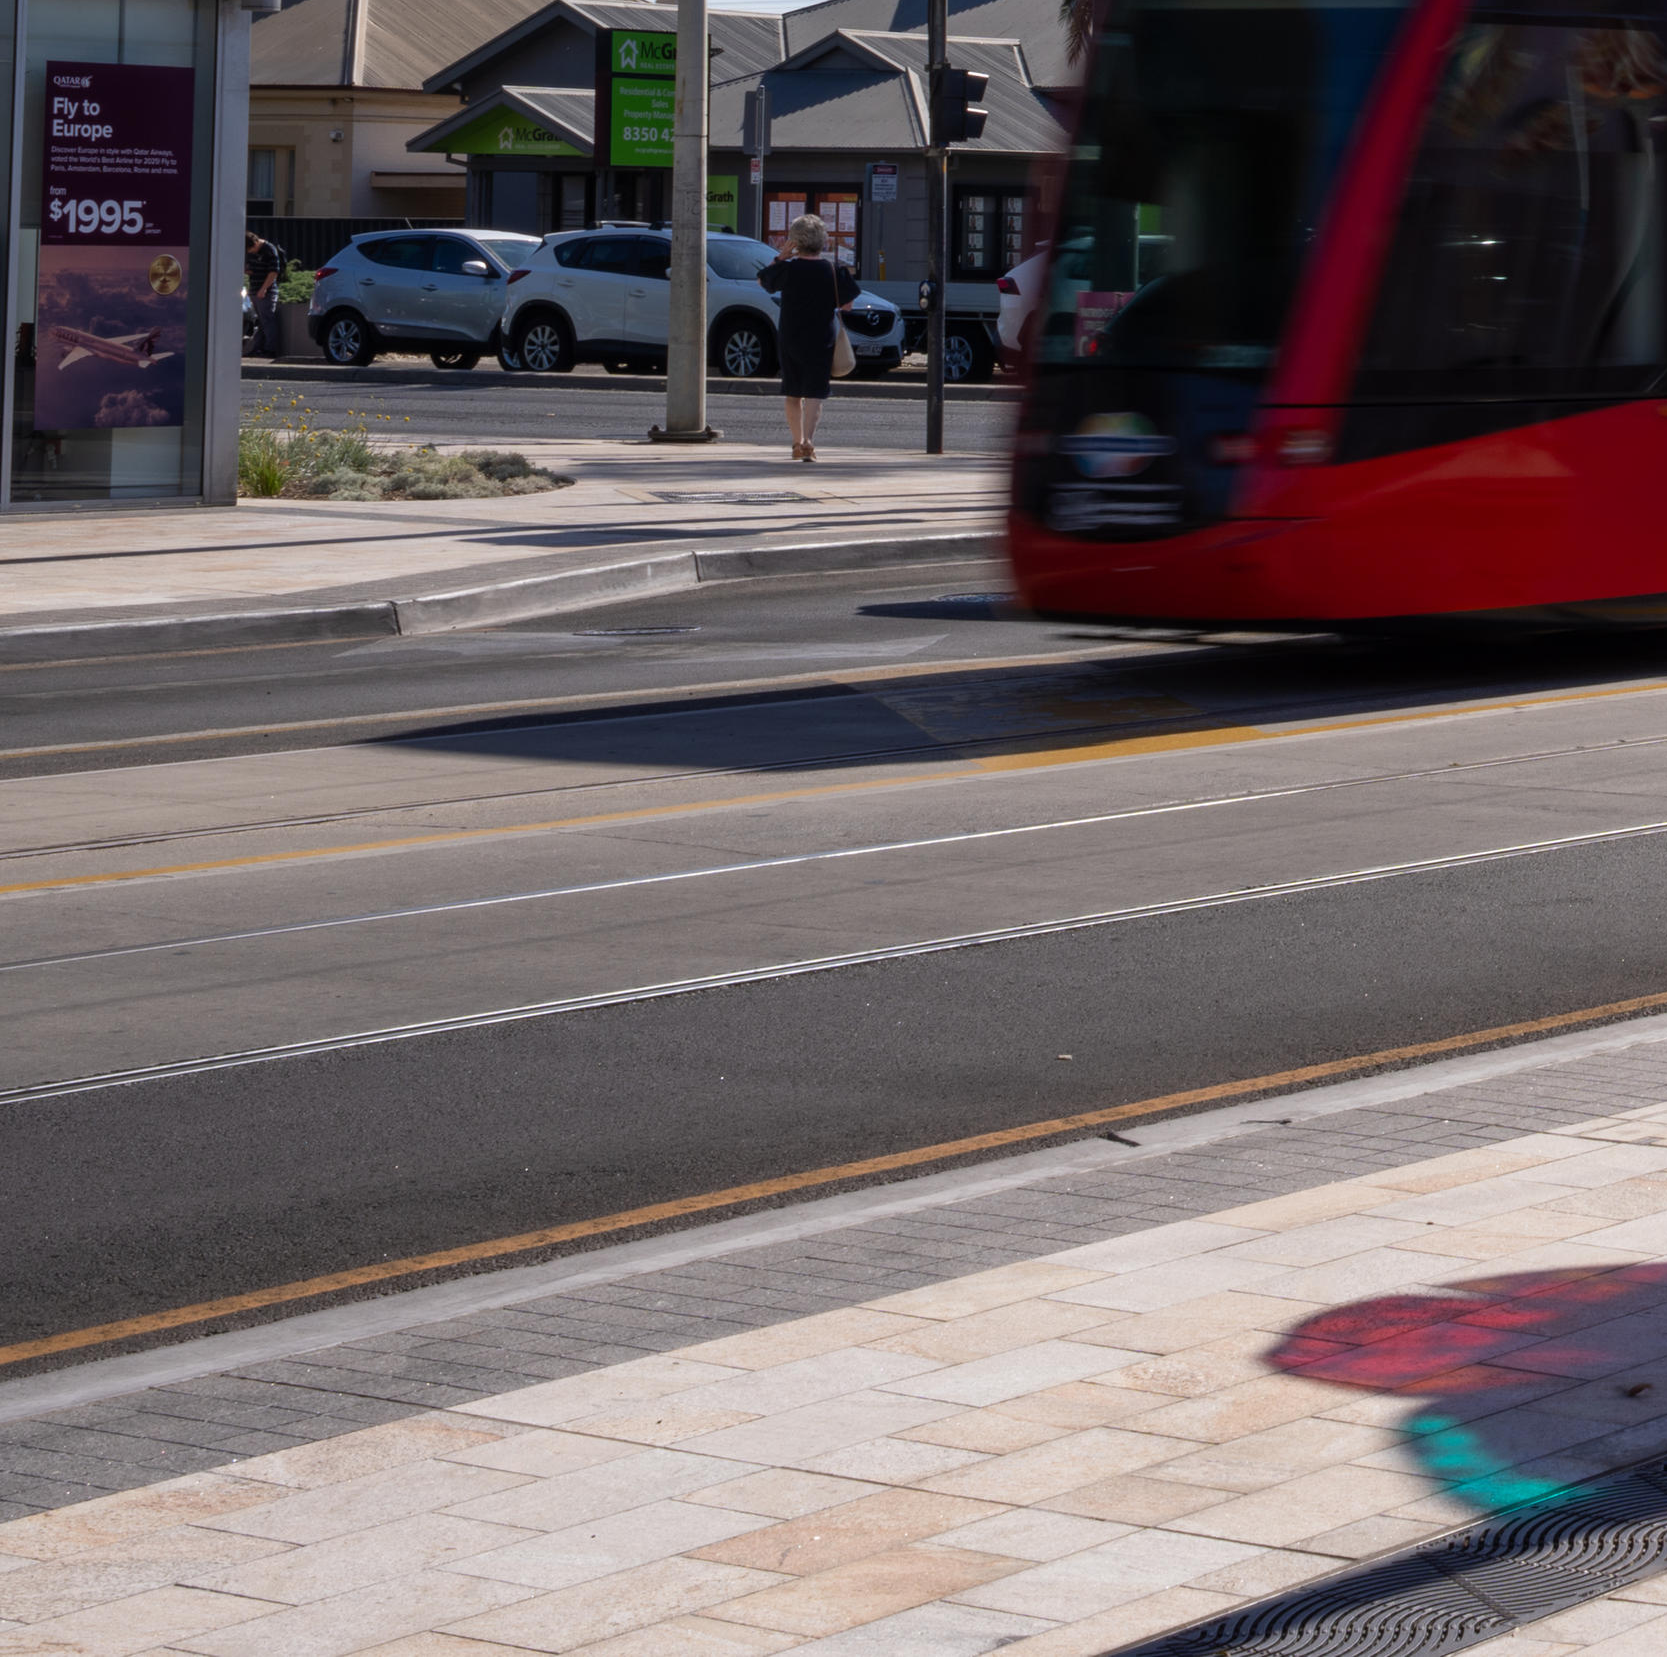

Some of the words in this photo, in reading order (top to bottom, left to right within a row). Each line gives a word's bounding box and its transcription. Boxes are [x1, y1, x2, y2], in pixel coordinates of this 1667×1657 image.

[640, 41, 677, 60] McGr
[53, 97, 78, 119] Fly
[82, 100, 100, 115] to
[53, 120, 113, 142] Europe
[516, 128, 561, 141] McGra
[623, 126, 658, 141] 8350
[661, 128, 675, 142] 42
[50, 186, 67, 195] from
[707, 190, 734, 202] Grath
